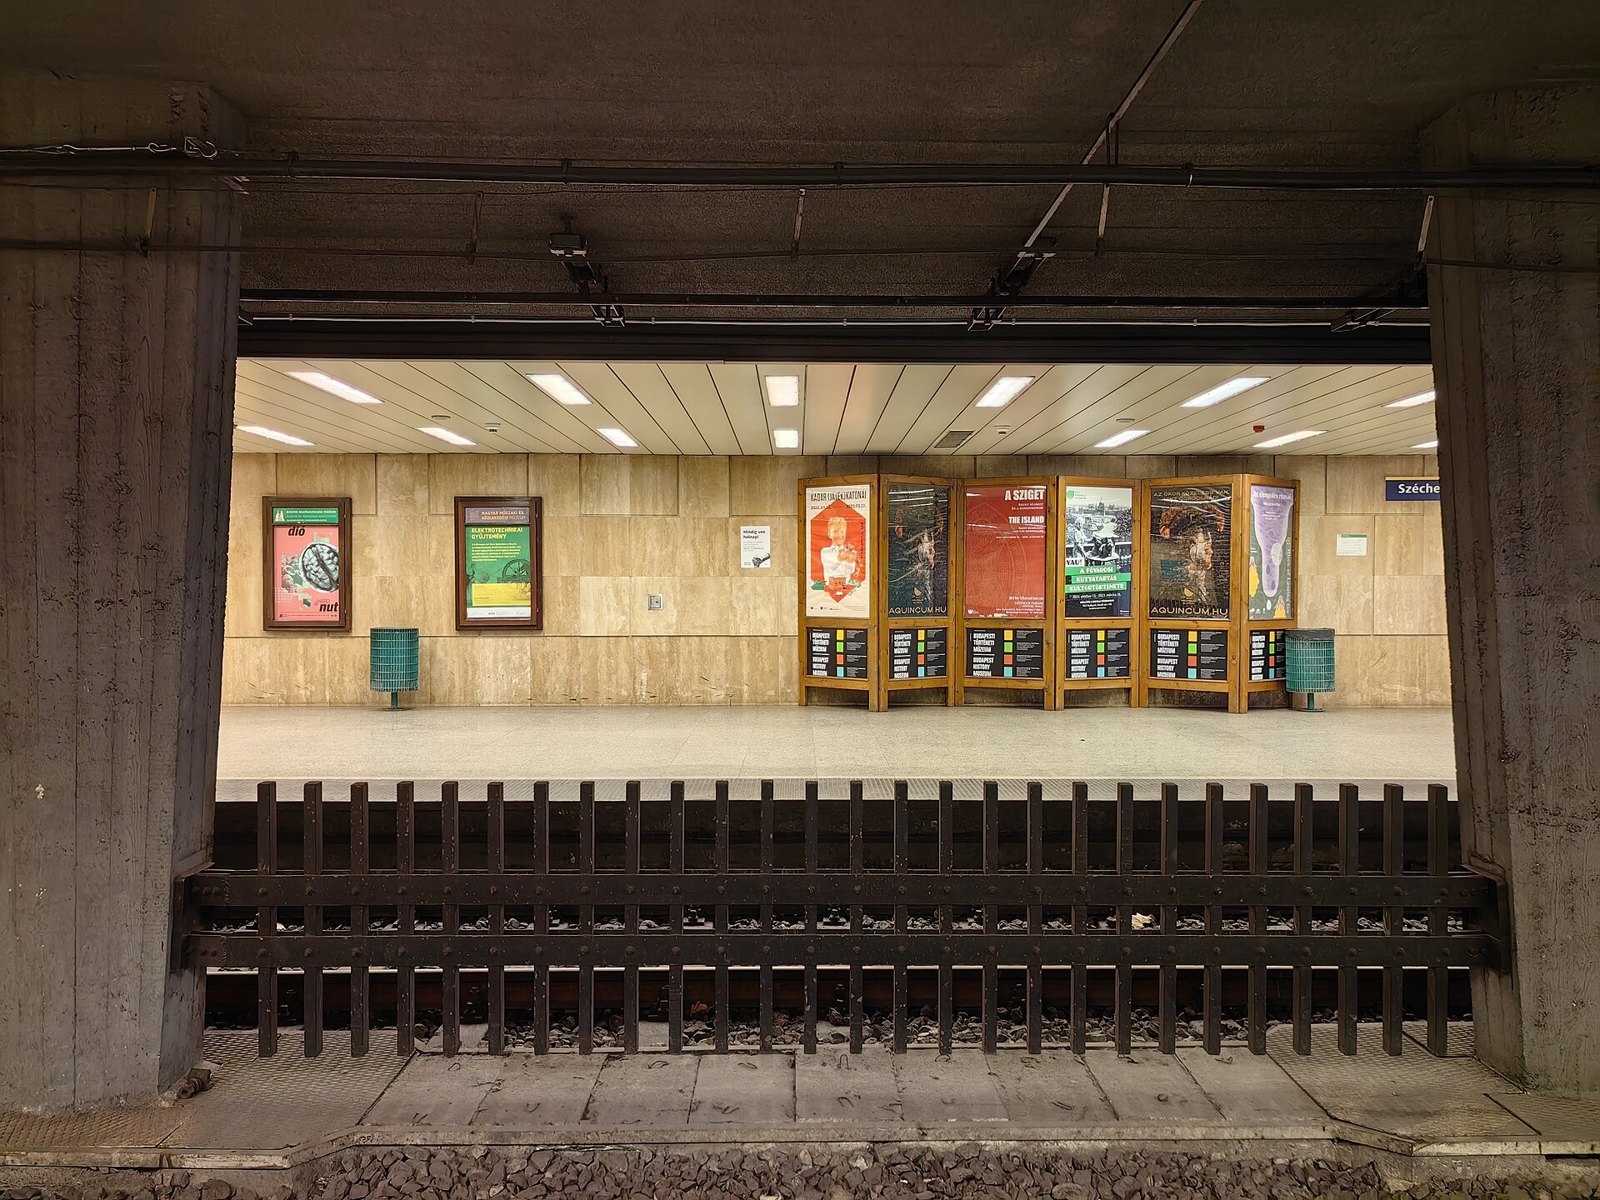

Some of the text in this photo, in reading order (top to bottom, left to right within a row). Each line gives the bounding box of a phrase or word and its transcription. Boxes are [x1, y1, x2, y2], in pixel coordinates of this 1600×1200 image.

[1005, 489, 1044, 501] A SZIGET
[320, 602, 338, 612] nut
[1151, 606, 1228, 616] AQUINCUM.HU
